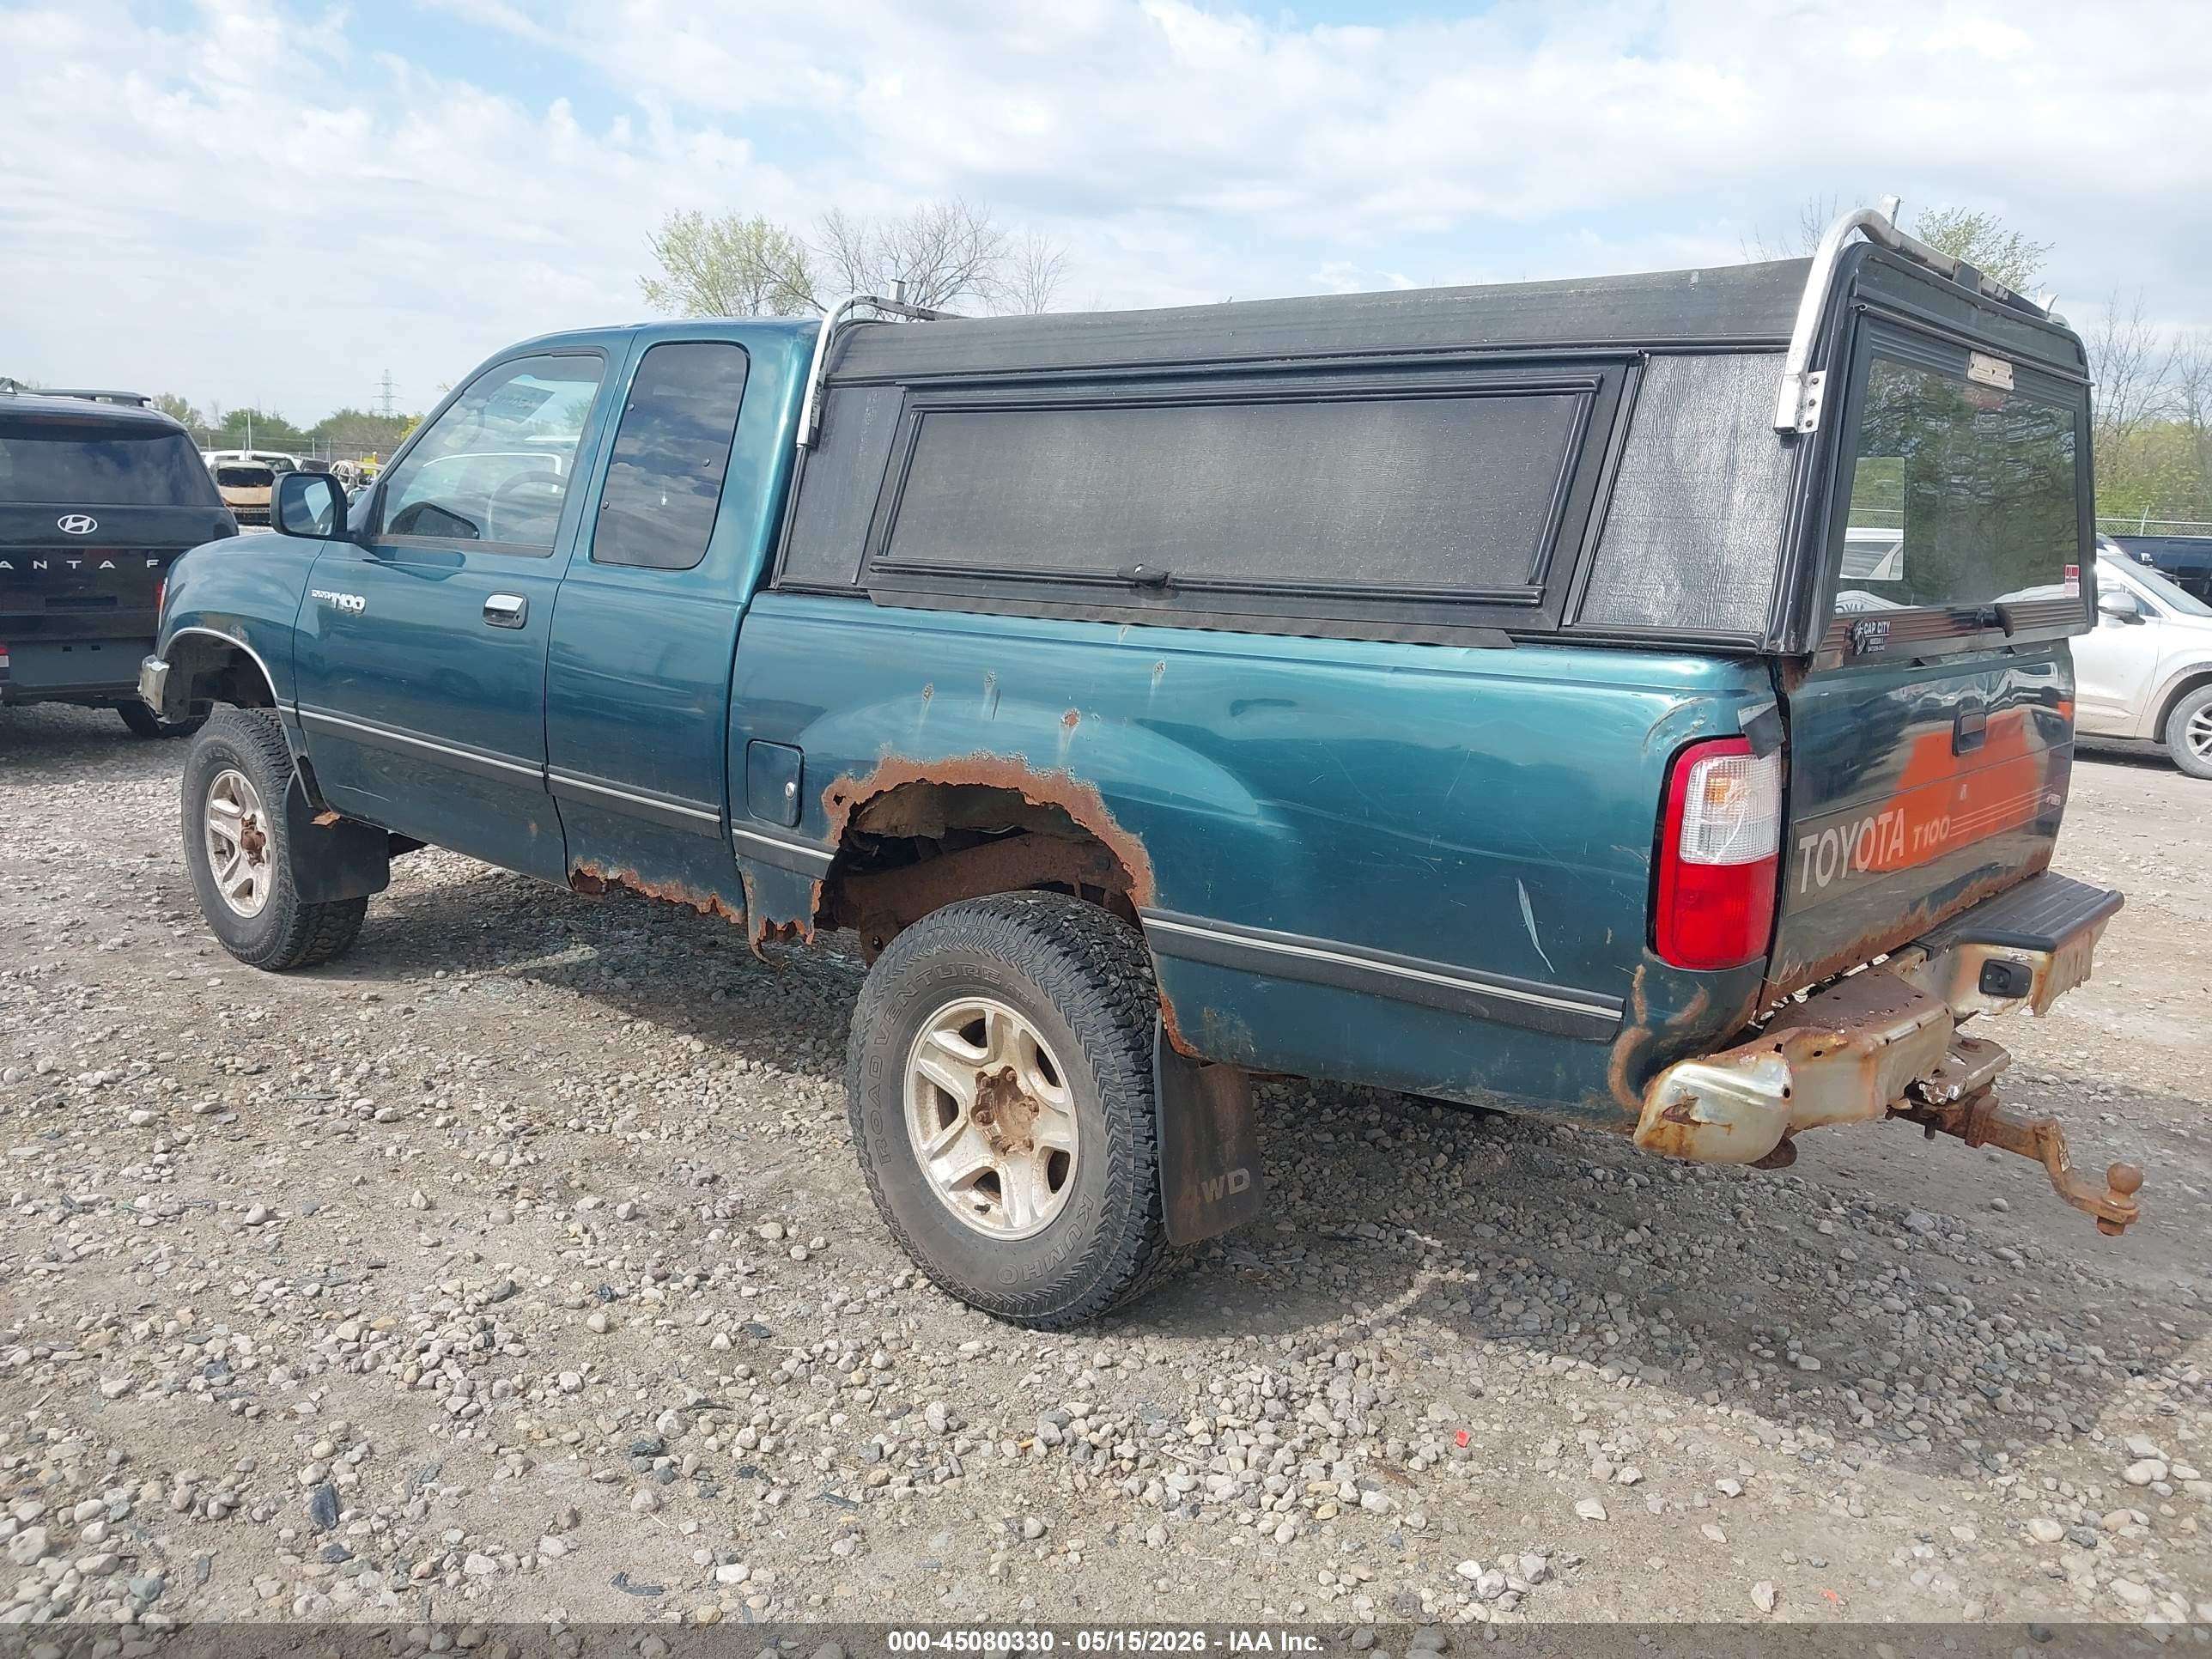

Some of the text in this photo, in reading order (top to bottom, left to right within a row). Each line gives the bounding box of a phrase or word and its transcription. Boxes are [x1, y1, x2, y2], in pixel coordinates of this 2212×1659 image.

[1863, 621, 1891, 635] CAP CITY
[1799, 808, 1951, 894] TOYOTA T100
[874, 961, 1003, 1045] VENTURE
[868, 1054, 892, 1167] ROAD
[1183, 1168, 1251, 1204] WD
[997, 1193, 1094, 1285] KUMHO
